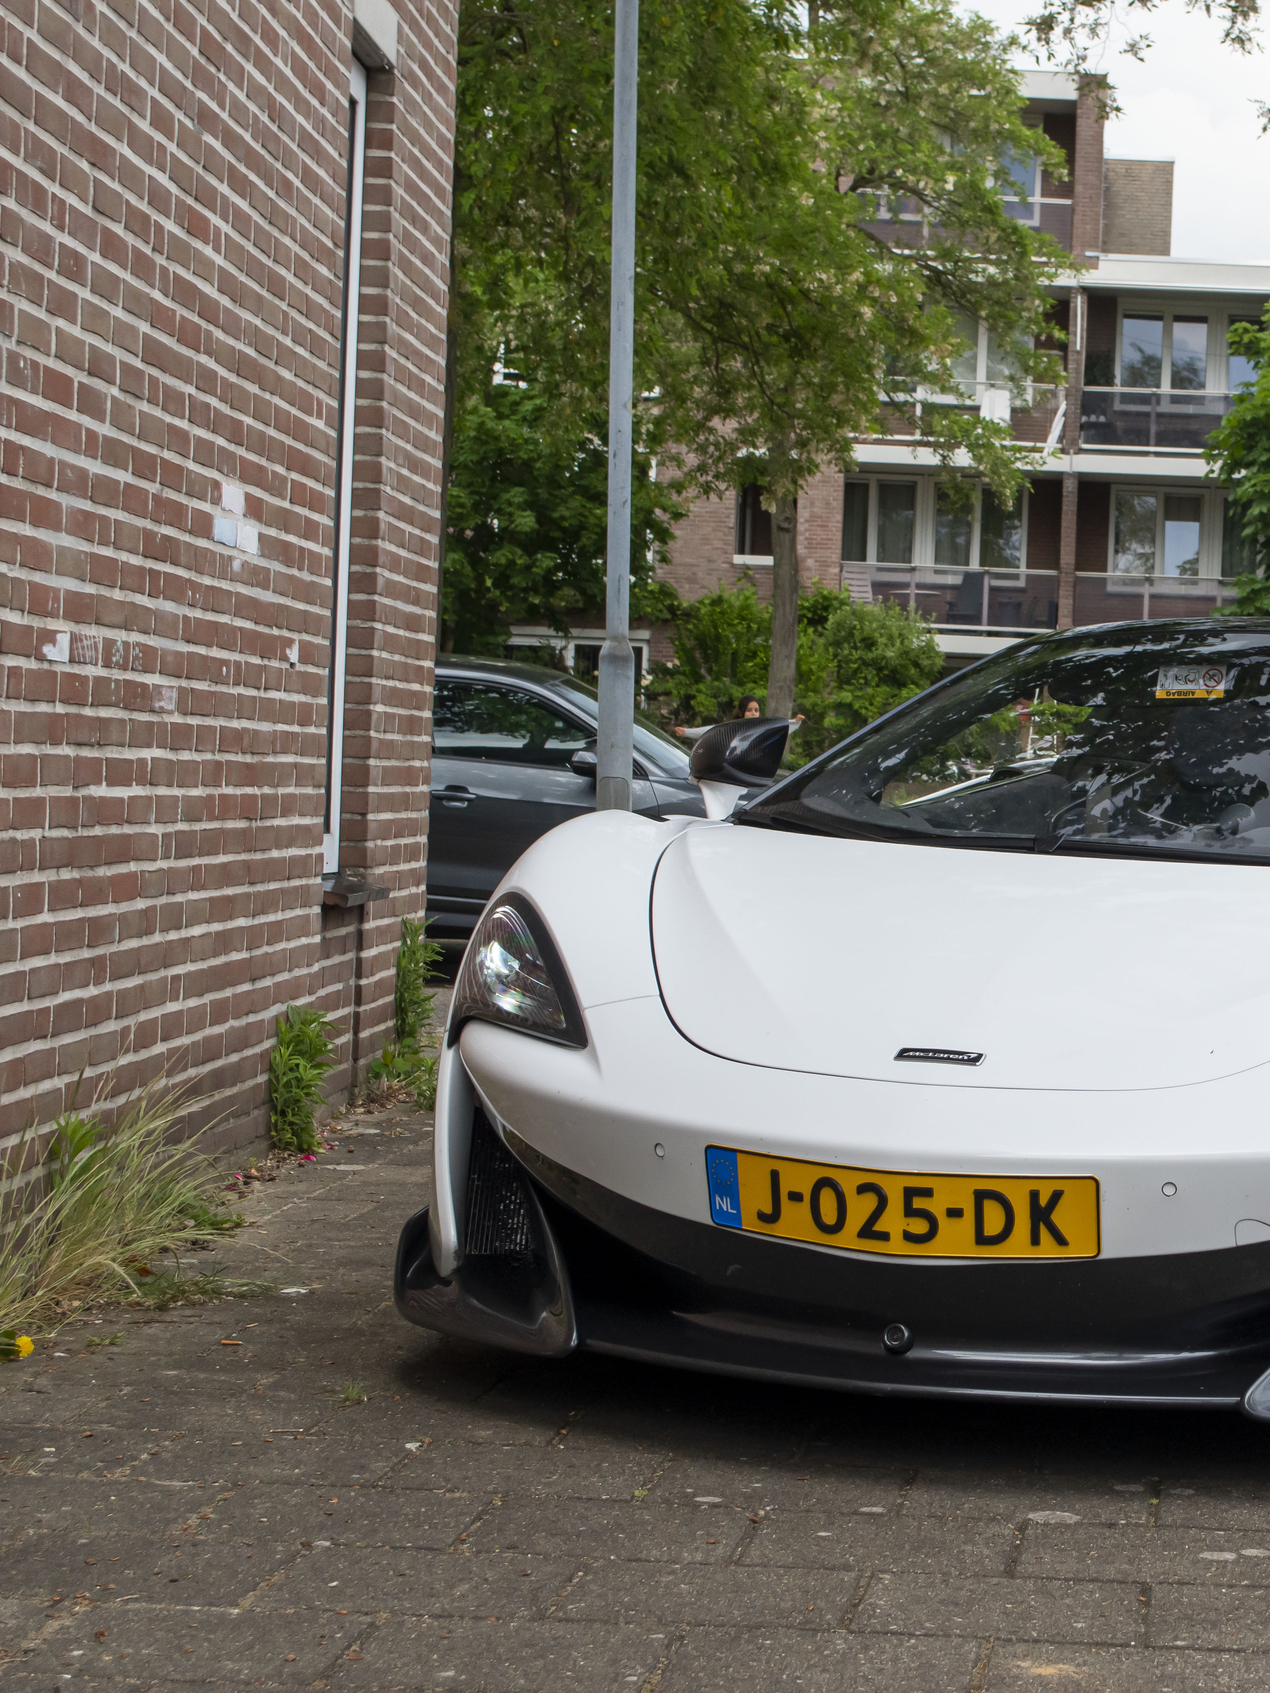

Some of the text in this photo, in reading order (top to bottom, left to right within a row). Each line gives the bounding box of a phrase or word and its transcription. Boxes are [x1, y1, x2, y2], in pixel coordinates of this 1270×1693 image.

[902, 1051, 970, 1061] McLaren
[715, 1194, 737, 1215] NL
[756, 1168, 1070, 1247] J-025-DK
